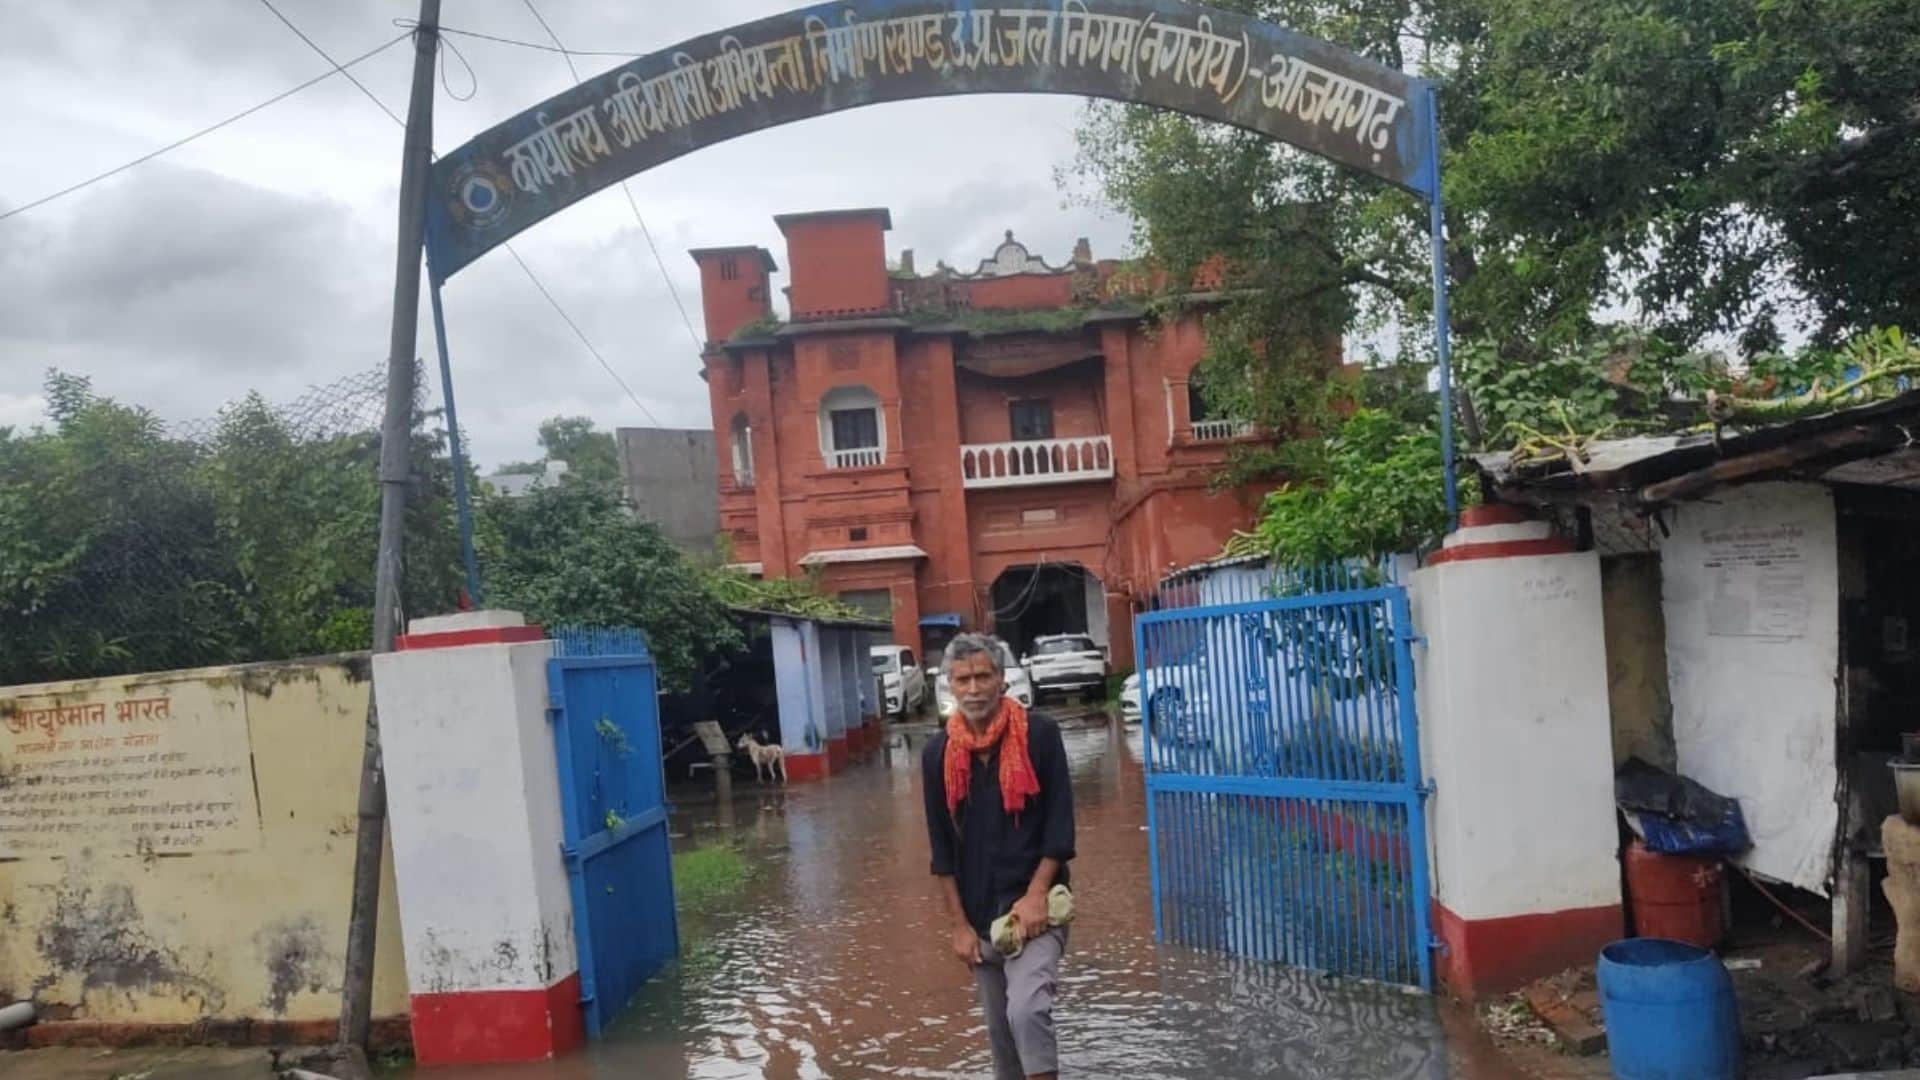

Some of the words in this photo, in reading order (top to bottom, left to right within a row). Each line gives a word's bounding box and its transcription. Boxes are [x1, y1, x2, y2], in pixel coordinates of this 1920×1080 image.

[503, 111, 613, 195] कार्यालय
[7, 702, 105, 737] आयुष्मान
[115, 697, 170, 723] भारत
